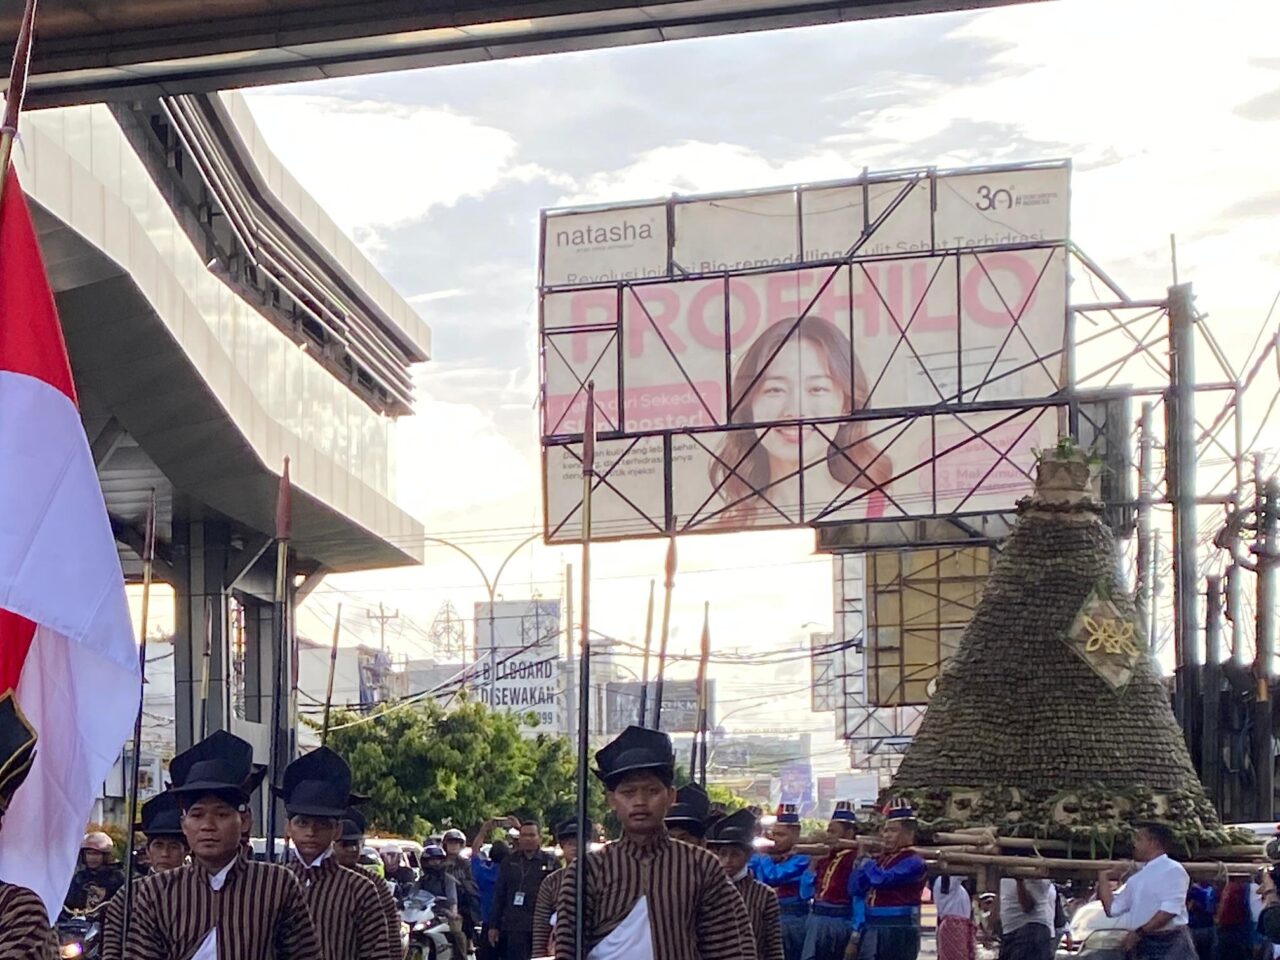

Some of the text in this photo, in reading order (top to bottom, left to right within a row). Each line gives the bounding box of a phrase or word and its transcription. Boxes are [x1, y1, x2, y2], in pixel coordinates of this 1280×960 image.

[556, 220, 653, 247] natasha
[570, 254, 1038, 364] PROFHILO
[483, 660, 552, 680] BLLBOARD
[481, 684, 554, 705] DISEWAKAN
